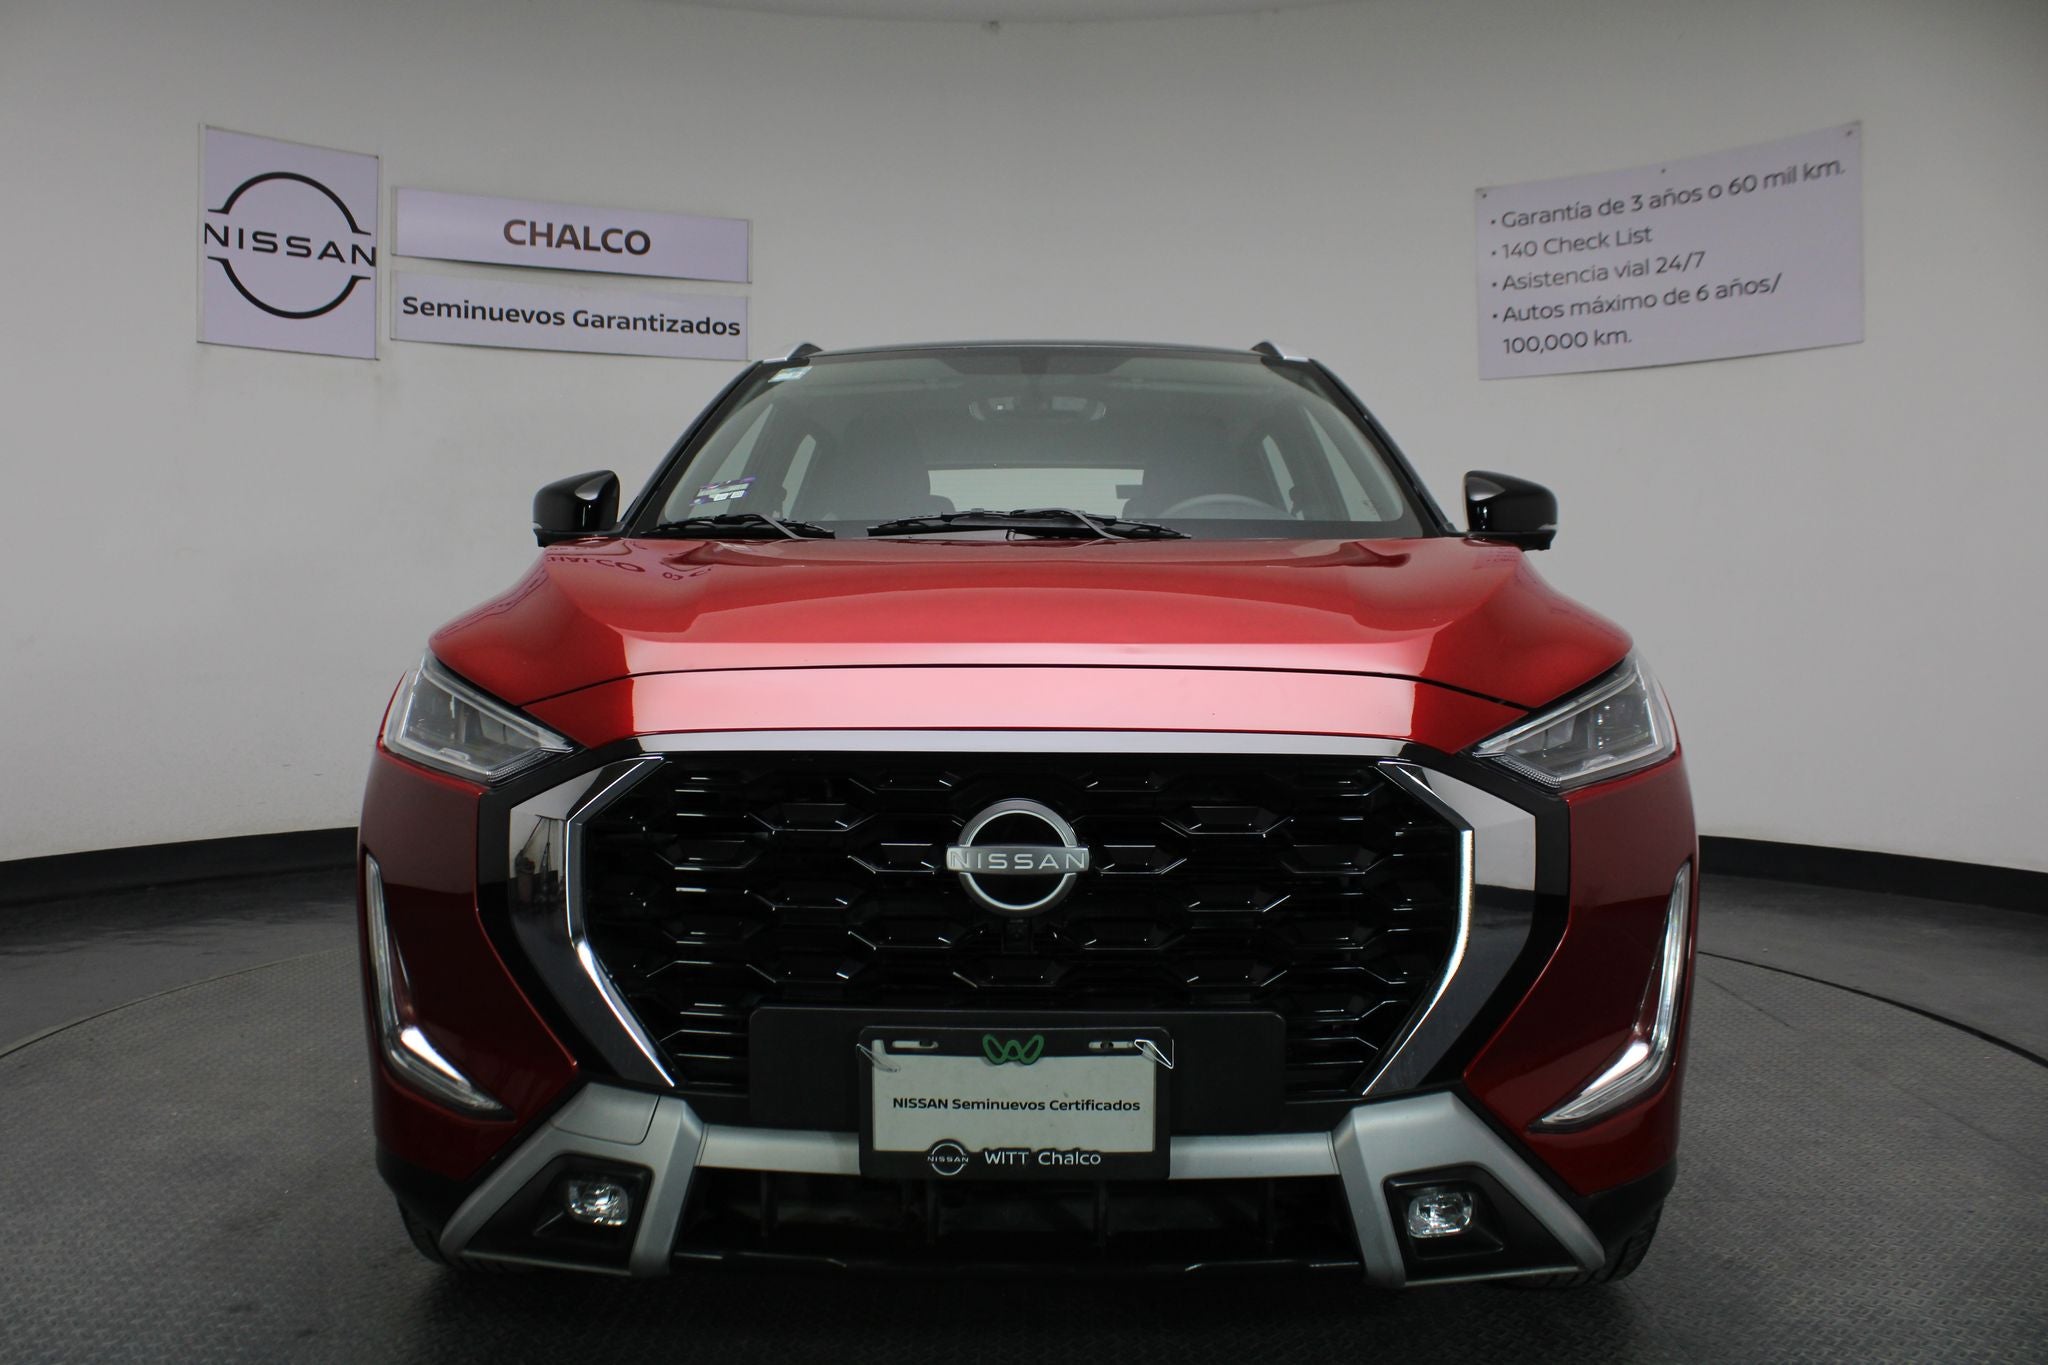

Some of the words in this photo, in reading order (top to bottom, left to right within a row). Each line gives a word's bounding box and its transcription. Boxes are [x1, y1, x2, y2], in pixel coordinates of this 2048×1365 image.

[1502, 199, 1592, 228] Garantía
[1597, 196, 1625, 216] de
[1631, 194, 1644, 212] 3
[1649, 186, 1703, 210] años
[1708, 182, 1723, 200] o
[1728, 174, 1757, 196] 60
[1762, 165, 1798, 189] mil
[1803, 158, 1846, 181] km.
[204, 222, 377, 267] NISSAN
[503, 218, 651, 256] CHALCO
[1502, 240, 1537, 259] 140
[1543, 231, 1610, 256] Check
[1615, 225, 1653, 247] List
[1502, 263, 1609, 291] Asistencia
[1614, 258, 1650, 279] vial
[1655, 251, 1705, 275] 24/7
[1502, 303, 1565, 323] Autos
[1570, 293, 1657, 317] máximo
[1663, 287, 1691, 308] de
[1696, 284, 1710, 302] 6
[1715, 272, 1782, 298] años/
[402, 296, 566, 328] Seminuevos
[572, 309, 741, 338] Garantizados
[1503, 330, 1588, 354] 100,000
[1594, 328, 1632, 347] km.
[951, 853, 1085, 870] NISSAN
[893, 1097, 948, 1110] NISSAN
[952, 1099, 1046, 1111] Seminuevos
[1049, 1099, 1141, 1112] Certificados
[927, 1155, 969, 1163] NISSAN
[984, 1151, 1029, 1165] WITT
[1038, 1151, 1101, 1166] Chalco
